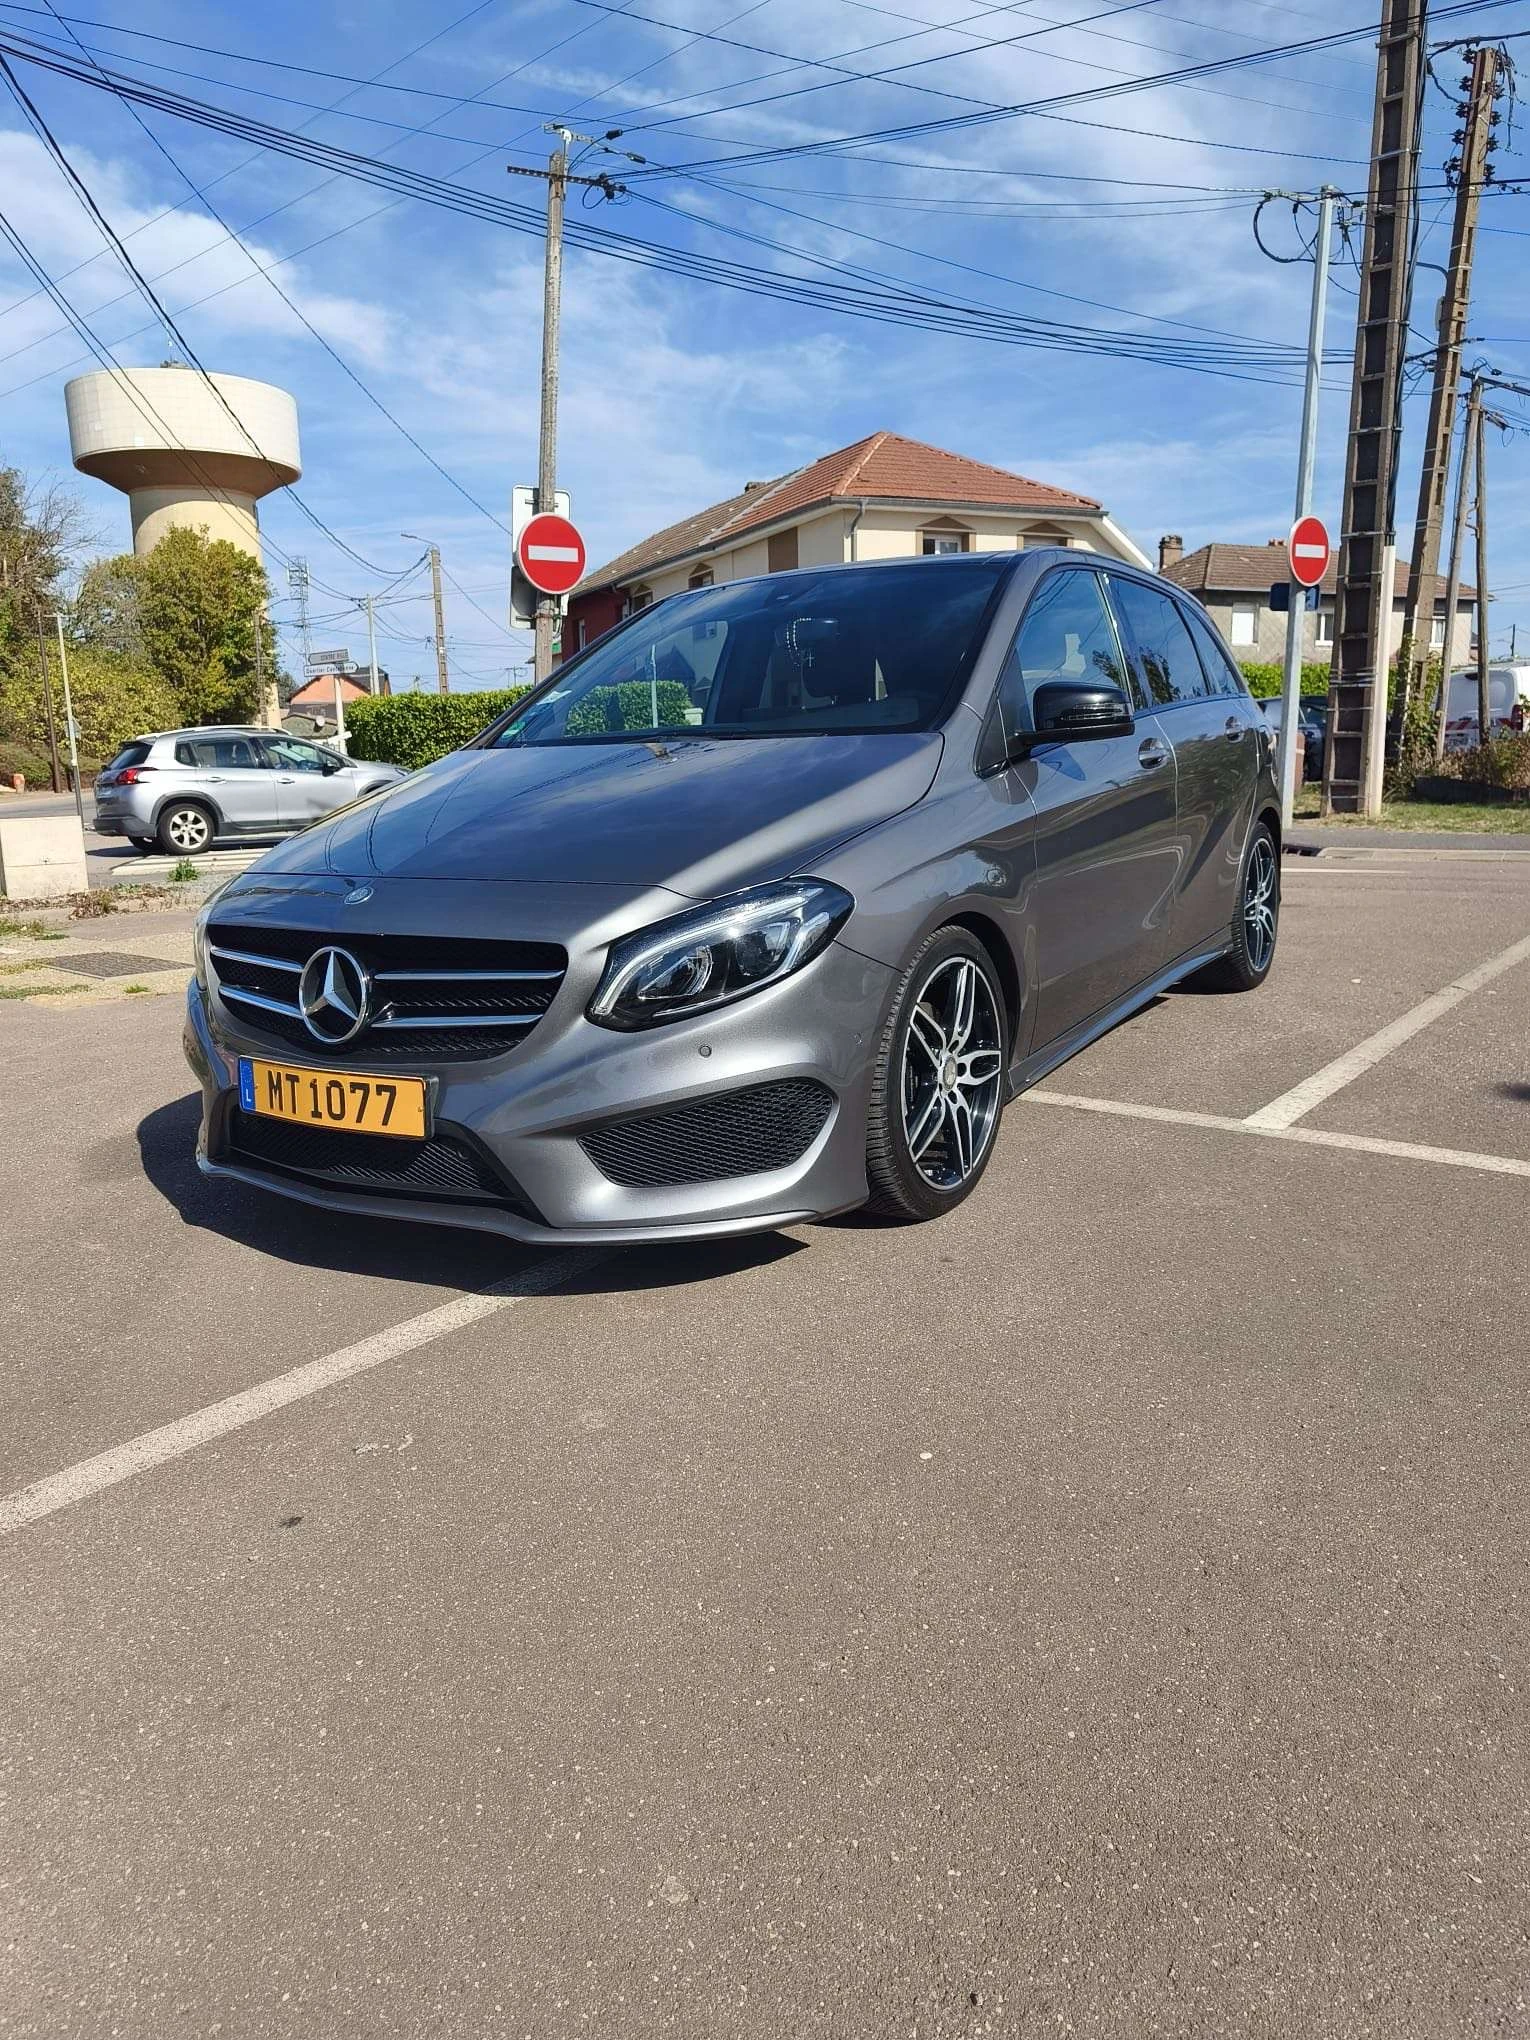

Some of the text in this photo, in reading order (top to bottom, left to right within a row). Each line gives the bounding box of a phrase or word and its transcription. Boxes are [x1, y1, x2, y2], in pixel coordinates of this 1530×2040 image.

[245, 1088, 252, 1102] L
[267, 1070, 397, 1126] MT 1077
